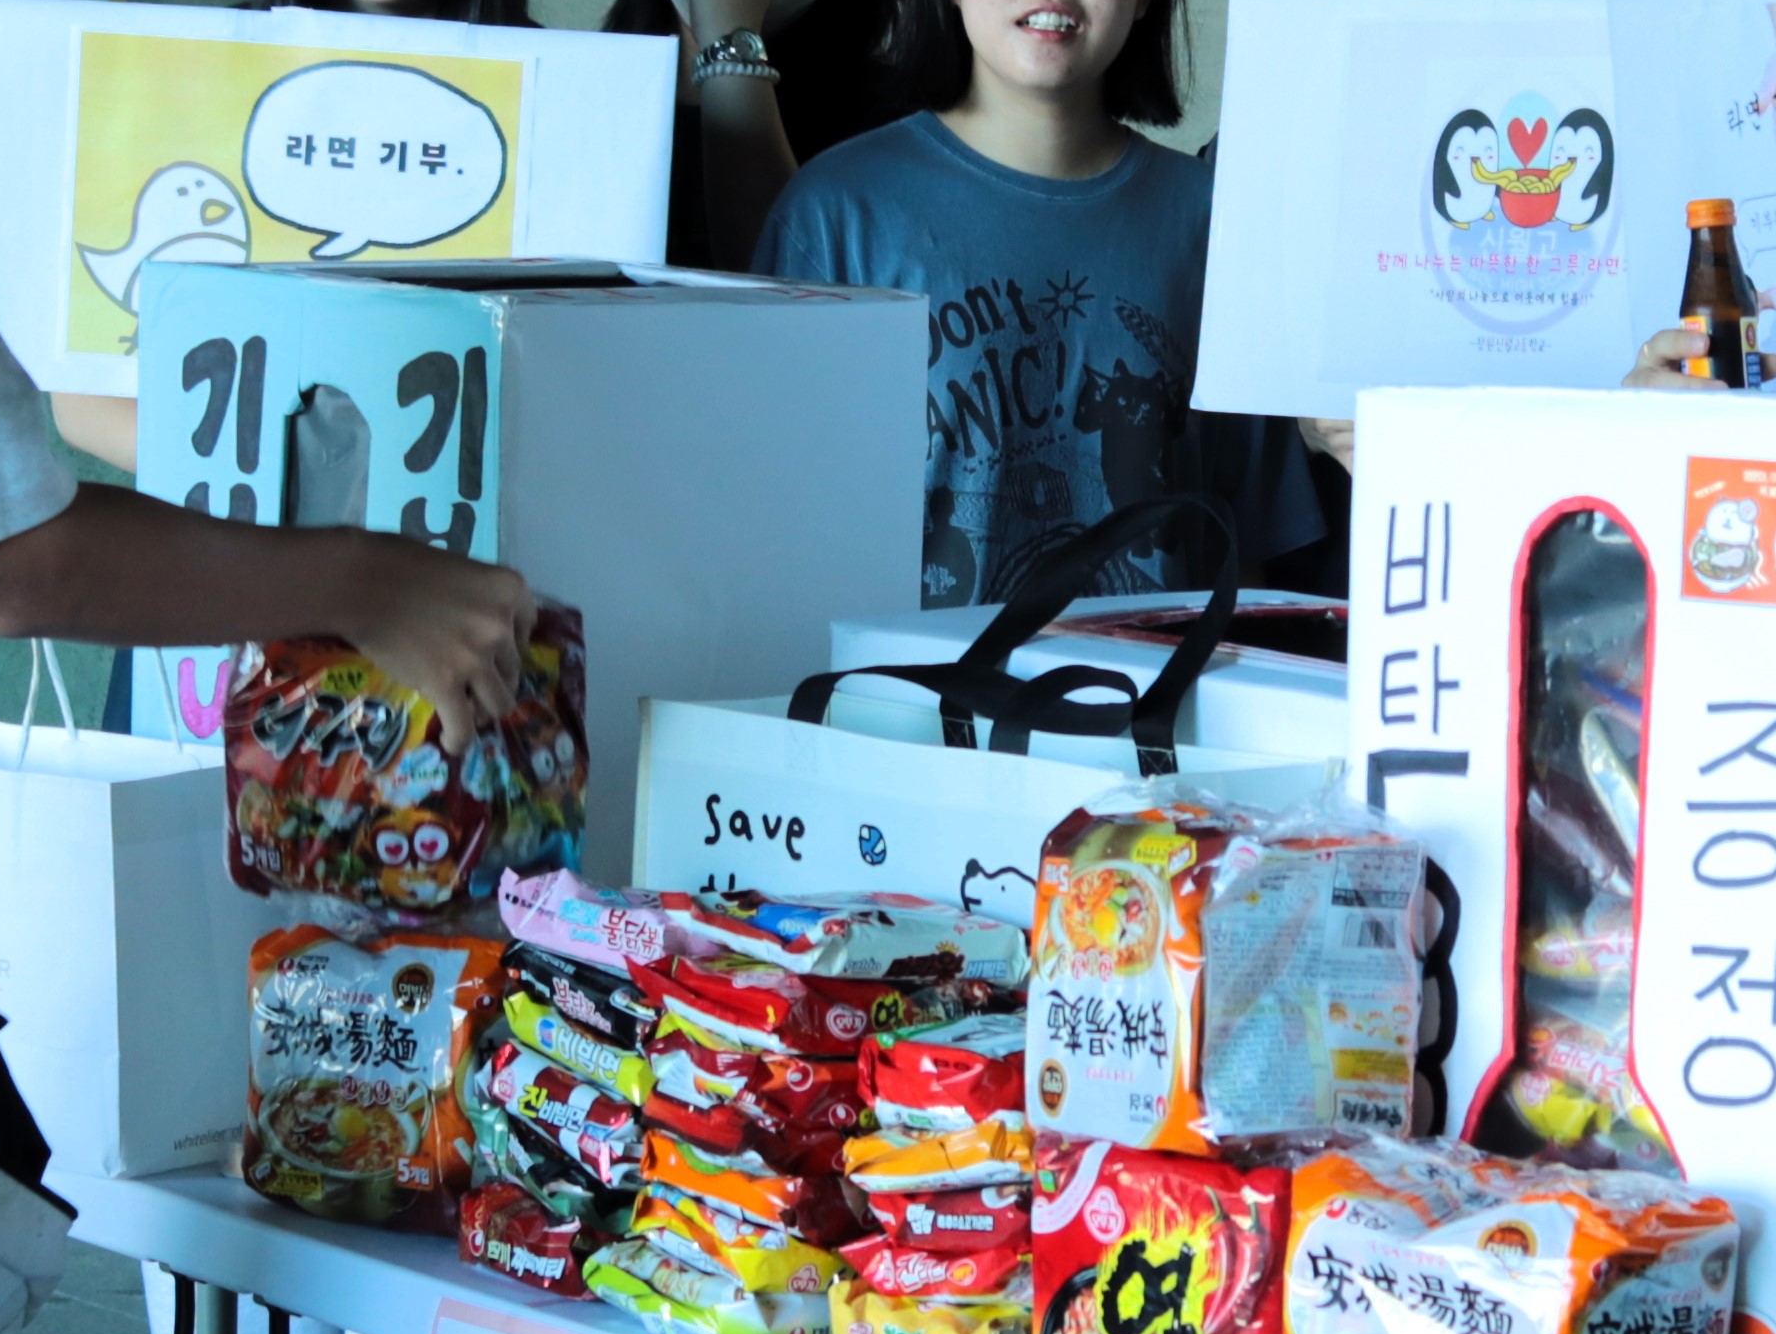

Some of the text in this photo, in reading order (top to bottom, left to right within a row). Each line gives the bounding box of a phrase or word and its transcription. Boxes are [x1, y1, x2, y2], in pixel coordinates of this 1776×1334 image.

[285, 134, 465, 176] 라면 기부.
[1376, 251, 1408, 273] 함께
[1414, 252, 1463, 273] 나누는
[1469, 252, 1518, 275] 따뜻한
[1526, 253, 1541, 275] 한
[926, 341, 1067, 460] ANIC!
[704, 793, 804, 861] Save
